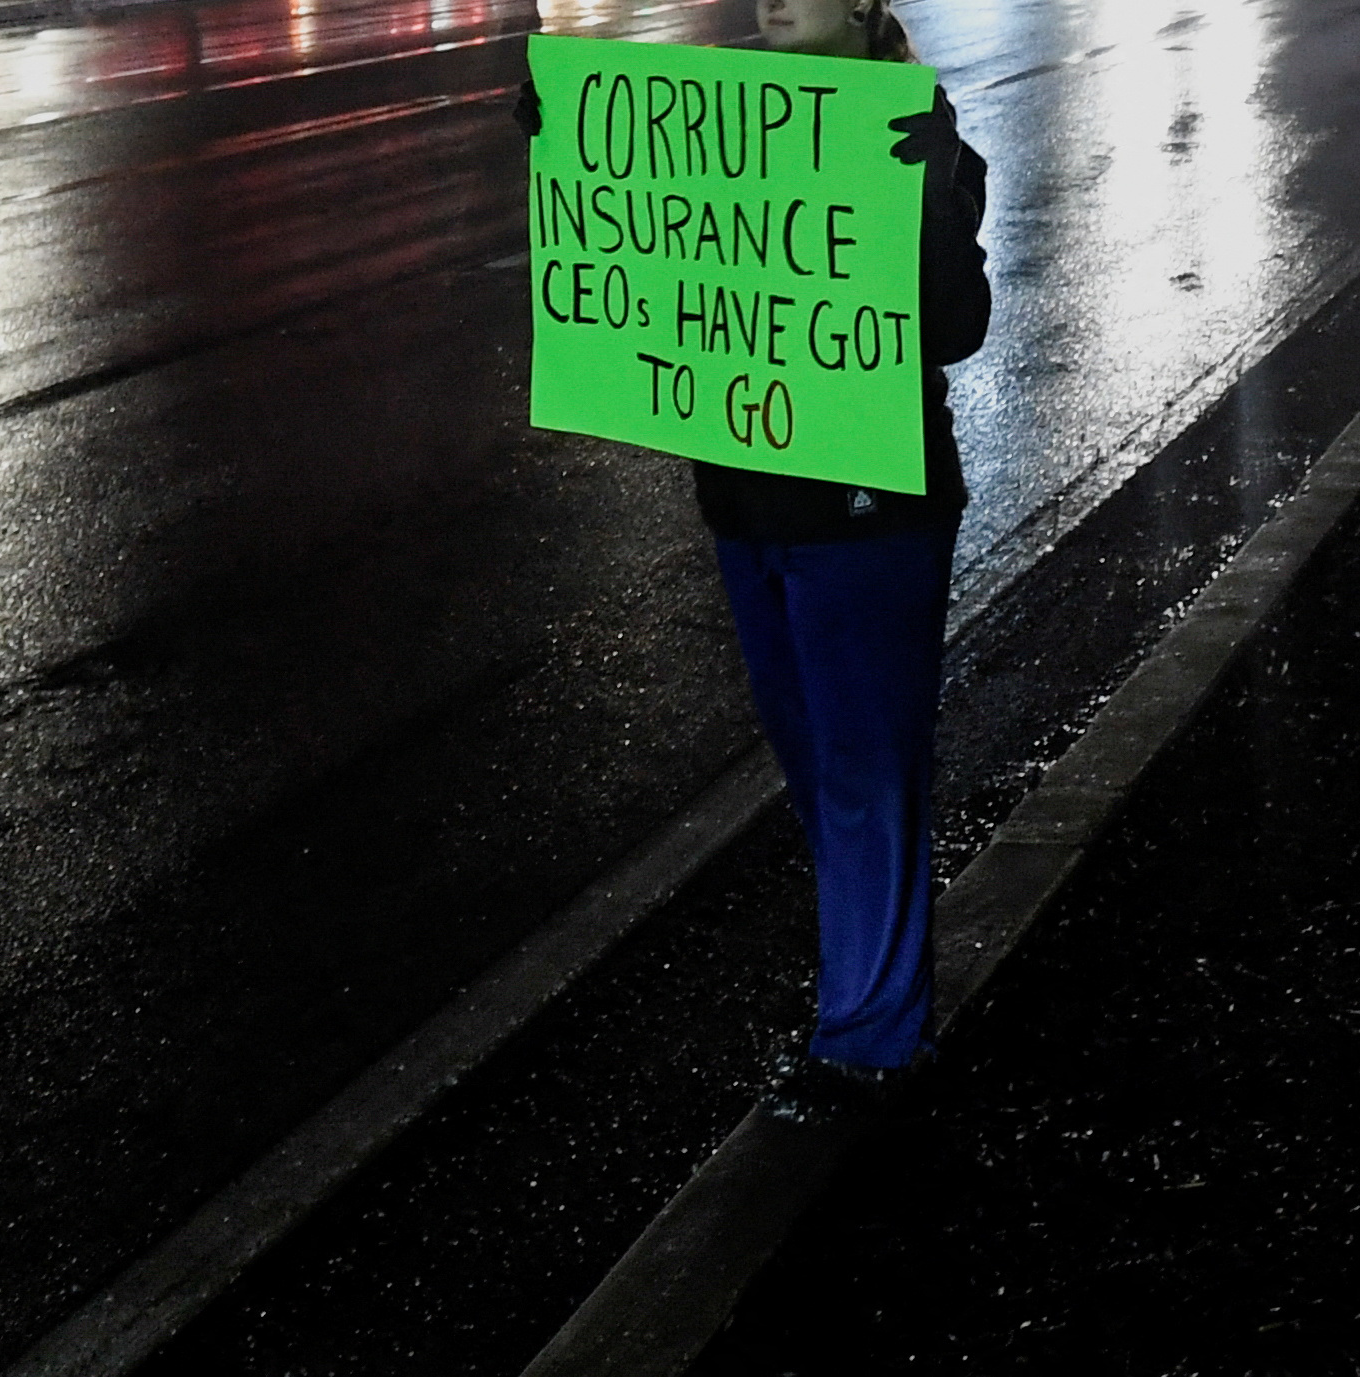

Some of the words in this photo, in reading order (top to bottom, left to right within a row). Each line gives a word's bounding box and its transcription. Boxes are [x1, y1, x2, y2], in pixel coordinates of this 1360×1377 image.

[577, 71, 838, 179] CORRUPT
[536, 171, 857, 279] INSURANCE
[541, 260, 650, 329] CEOs
[677, 280, 795, 366] HAVE
[808, 299, 911, 371] GOT
[636, 353, 695, 420] TO
[726, 374, 793, 451] GO
